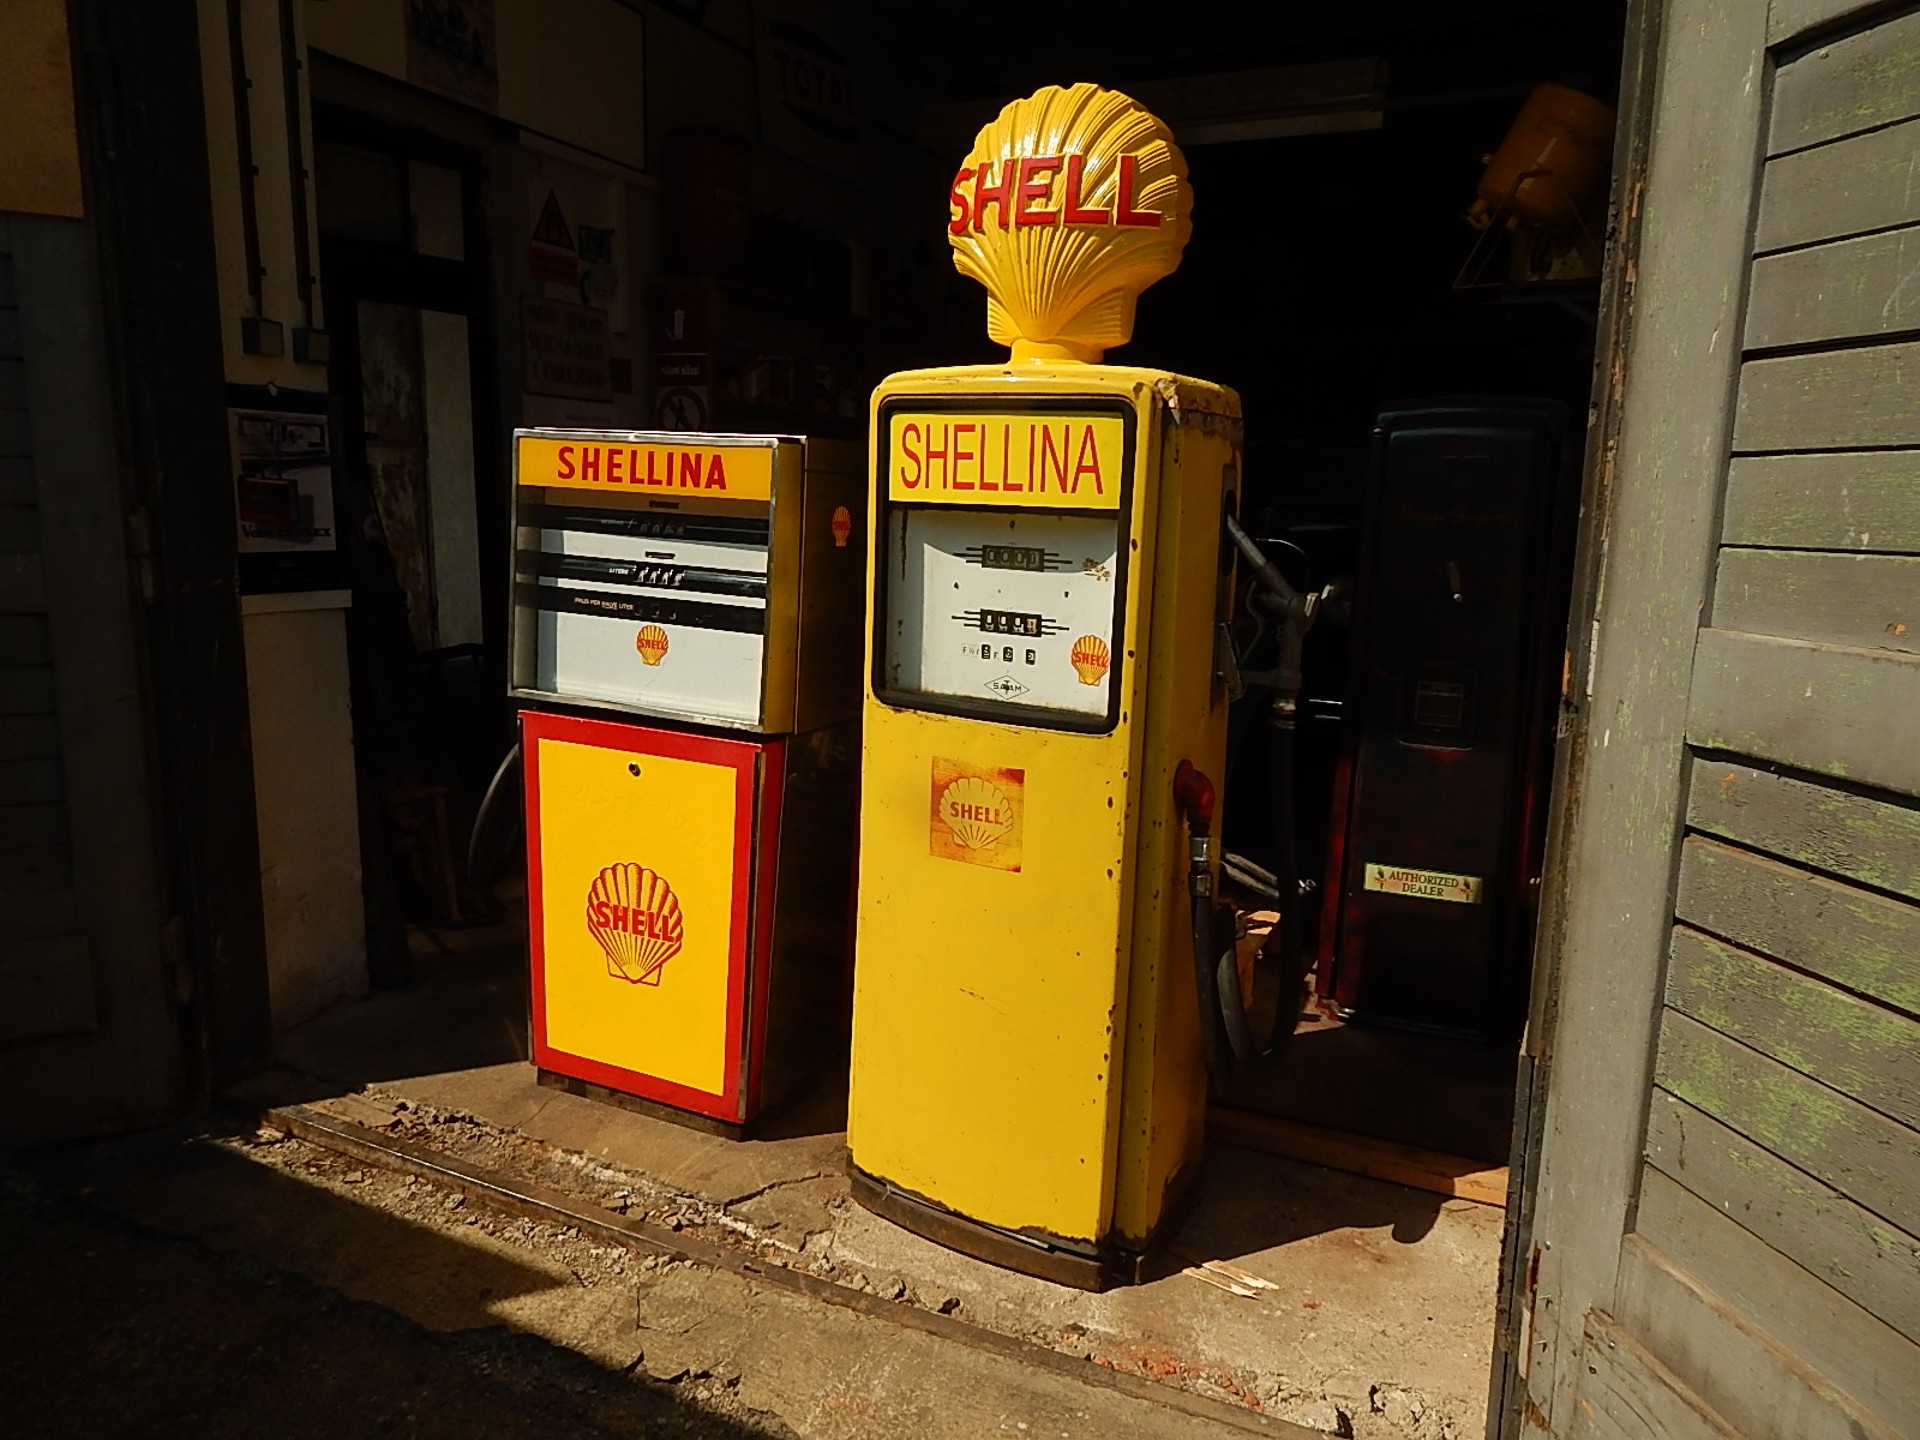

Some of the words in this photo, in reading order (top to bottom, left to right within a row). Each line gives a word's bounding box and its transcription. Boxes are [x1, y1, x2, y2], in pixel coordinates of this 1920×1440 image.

[950, 153, 1162, 235] SHELL
[557, 446, 727, 490] SHELLINA
[900, 423, 1104, 495] SHELLINA
[637, 638, 668, 651] SHELL
[1073, 651, 1109, 668] SHELL
[949, 801, 1004, 826] SHELL
[1389, 871, 1459, 888] AUTHORIZED
[1402, 883, 1444, 897] DEALER
[596, 901, 676, 943] SHELL
